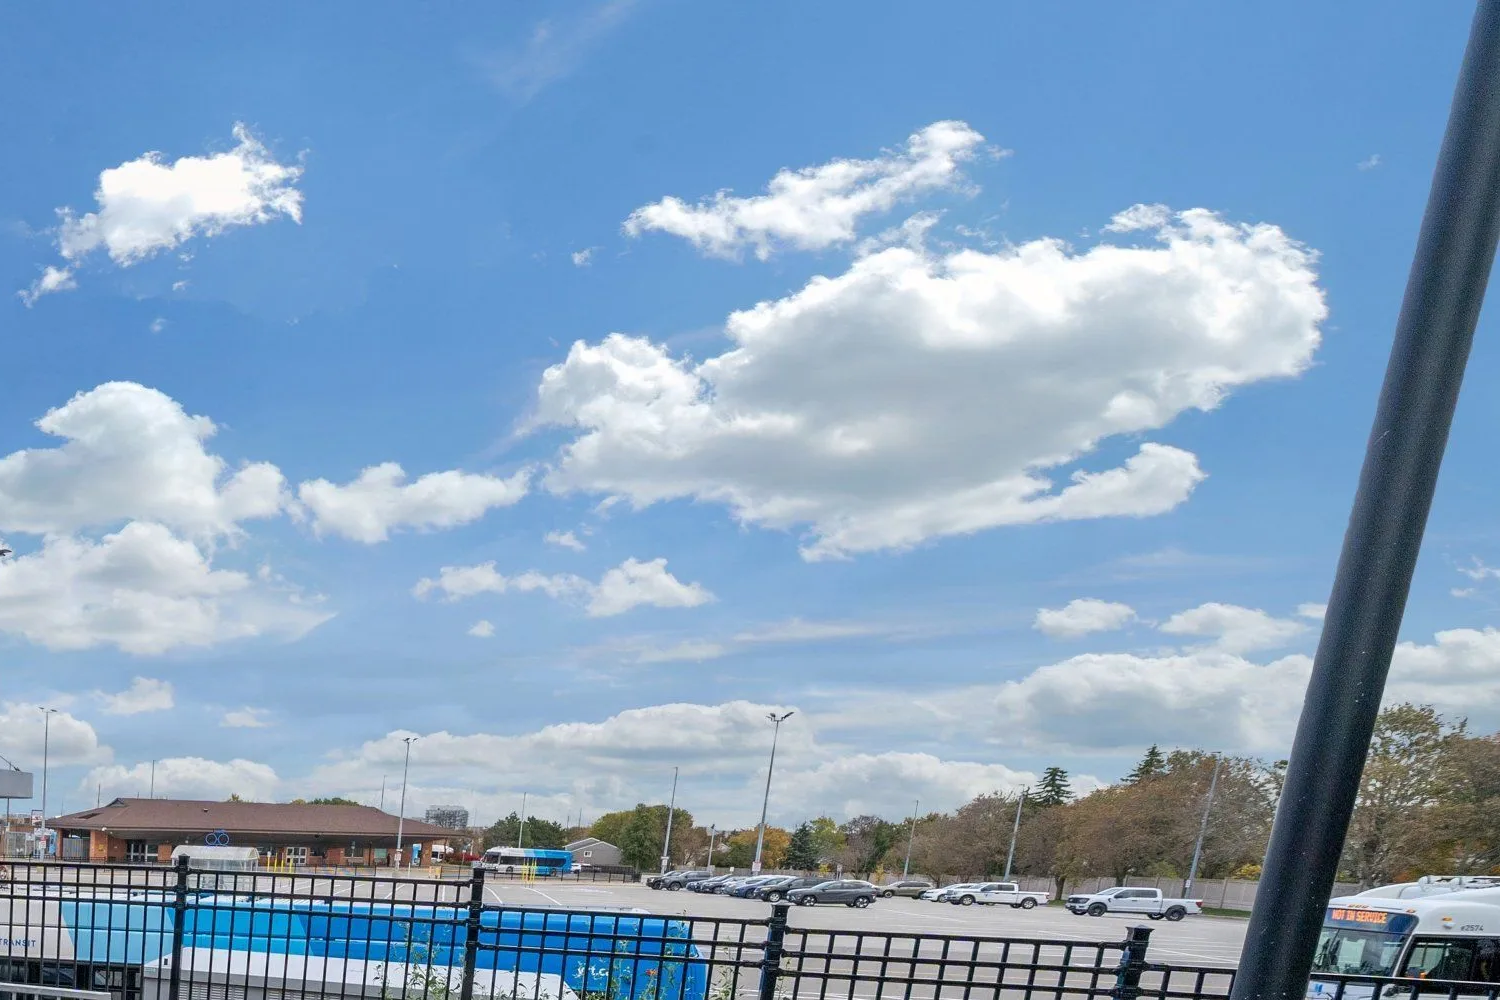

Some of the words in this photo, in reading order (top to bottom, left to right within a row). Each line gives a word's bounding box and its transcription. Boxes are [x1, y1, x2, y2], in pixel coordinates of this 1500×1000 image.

[1332, 909, 1345, 920] NOT
[1346, 910, 1355, 921] IN
[1356, 911, 1388, 924] SERVICE
